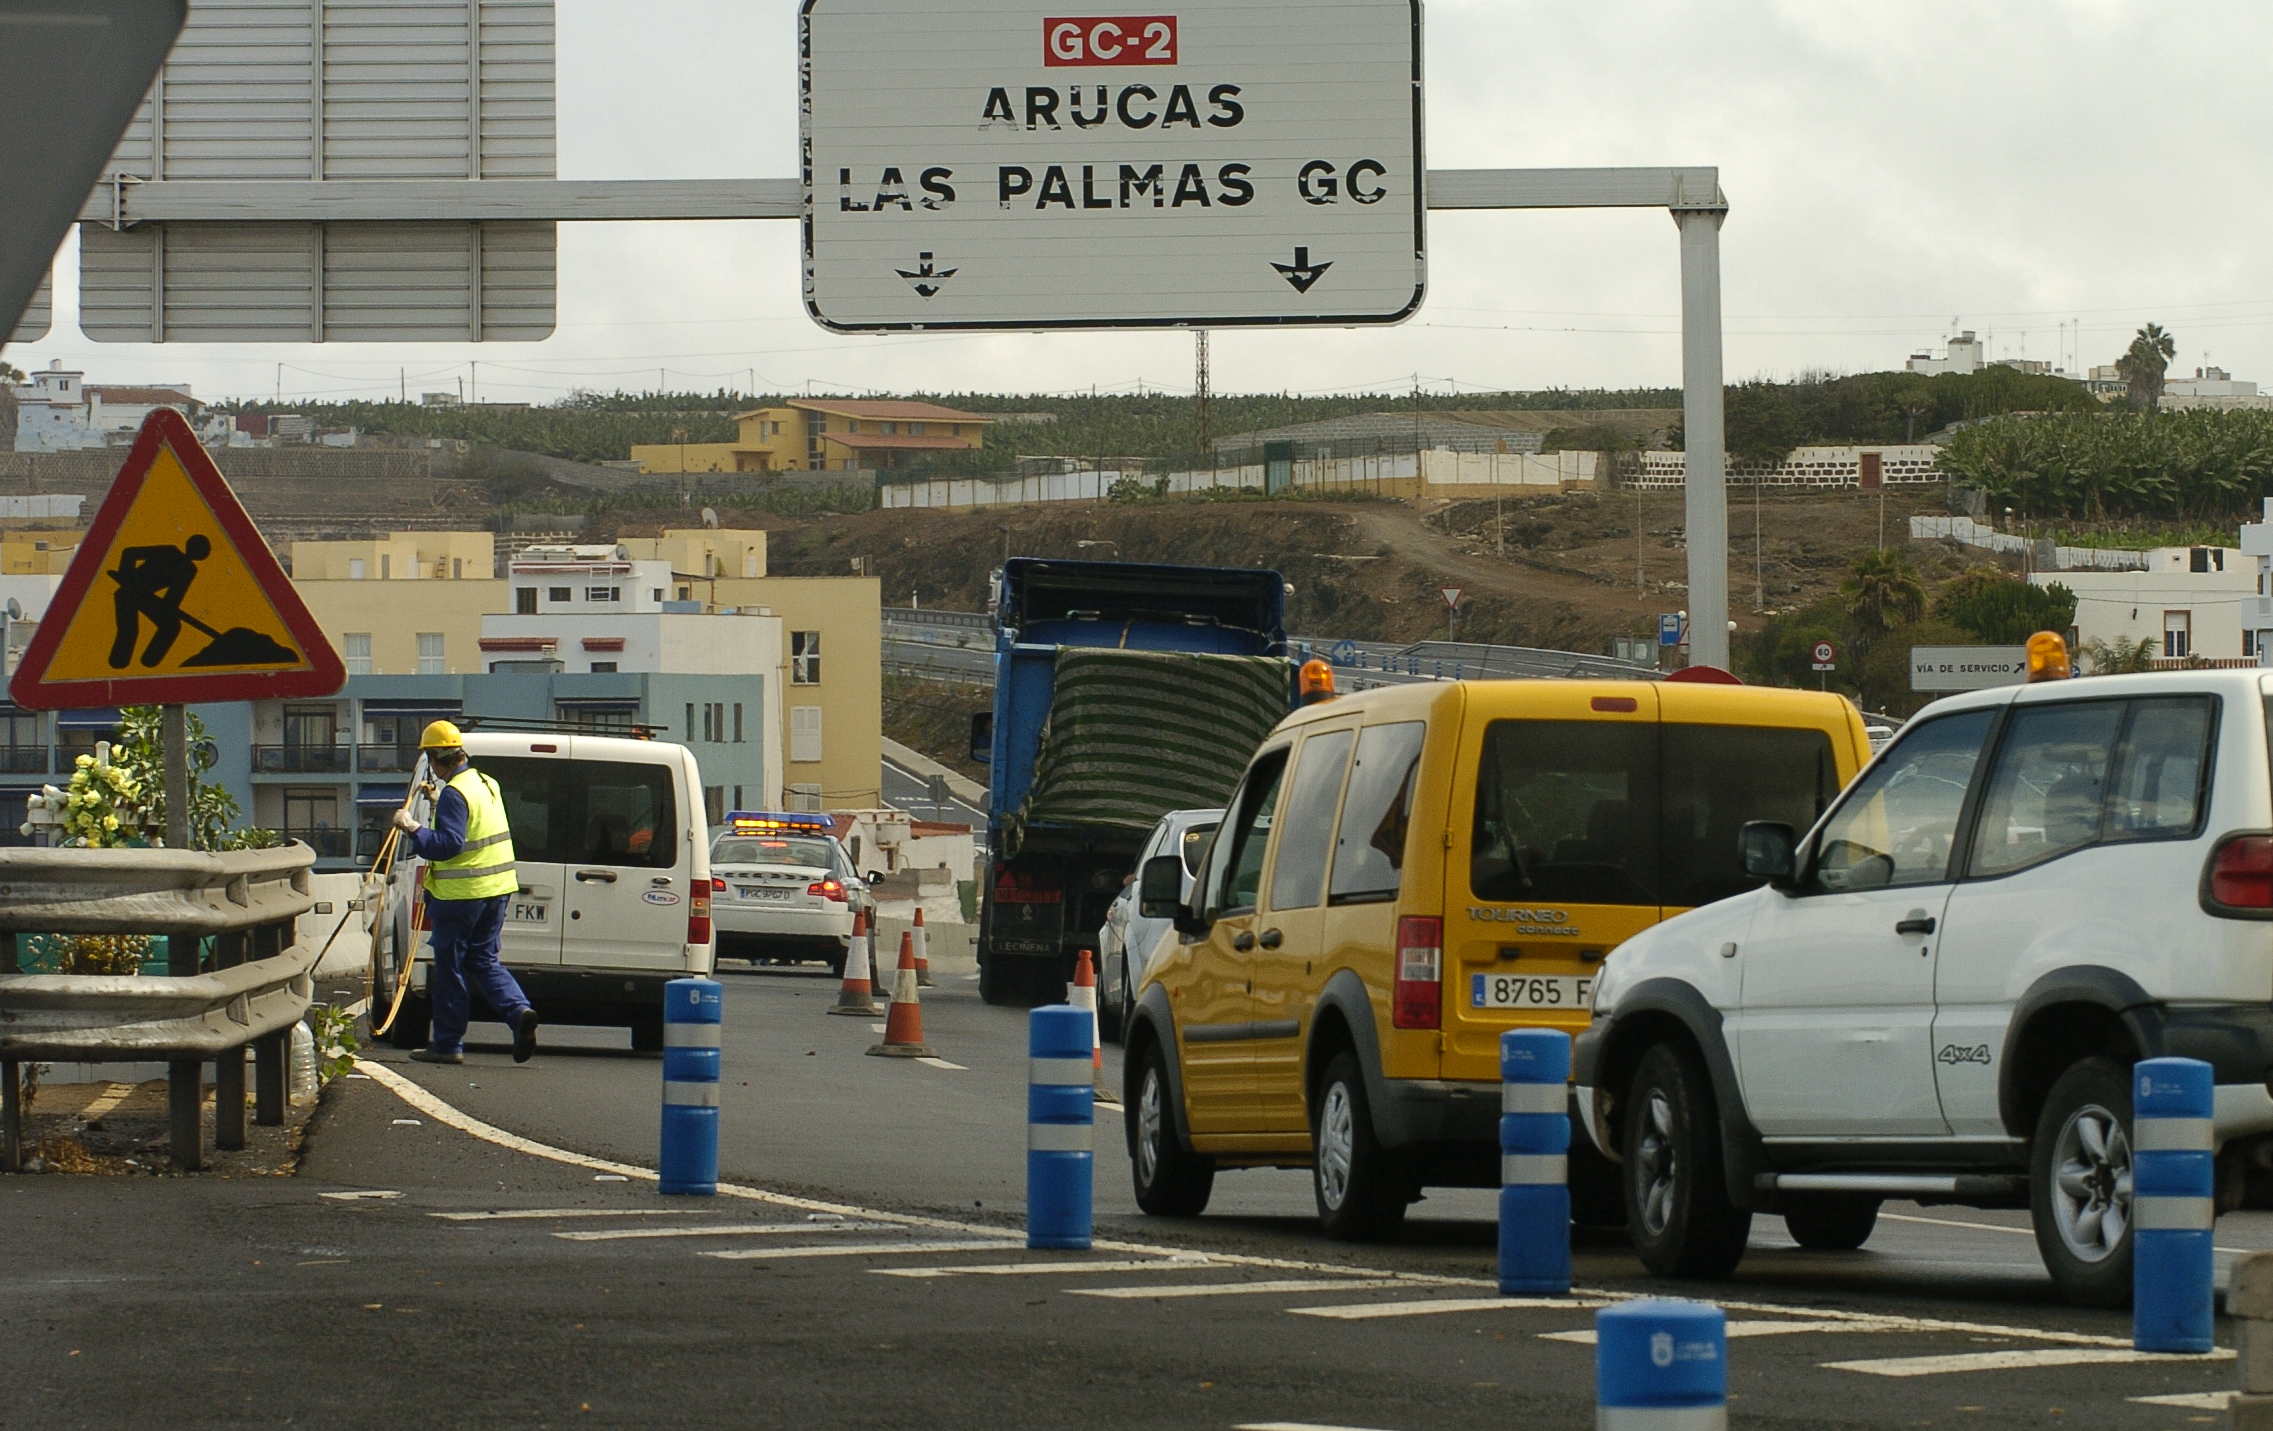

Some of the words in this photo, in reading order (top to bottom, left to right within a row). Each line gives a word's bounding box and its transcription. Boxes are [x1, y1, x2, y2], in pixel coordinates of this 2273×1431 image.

[1051, 22, 1173, 62] GC-2
[978, 84, 1245, 132] ARUCAS
[840, 167, 957, 212] LAS
[1000, 163, 1255, 210] PALMAS
[1298, 159, 1388, 206] GC
[1916, 662, 1934, 673] VÍA
[1939, 664, 1953, 673] DE
[1960, 664, 2010, 673] SERVICIO
[515, 904, 545, 921] FKW
[1466, 907, 1569, 924] TOURNEO
[1495, 977, 1562, 1004] 8765
[1938, 1044, 1992, 1065] 4x4
